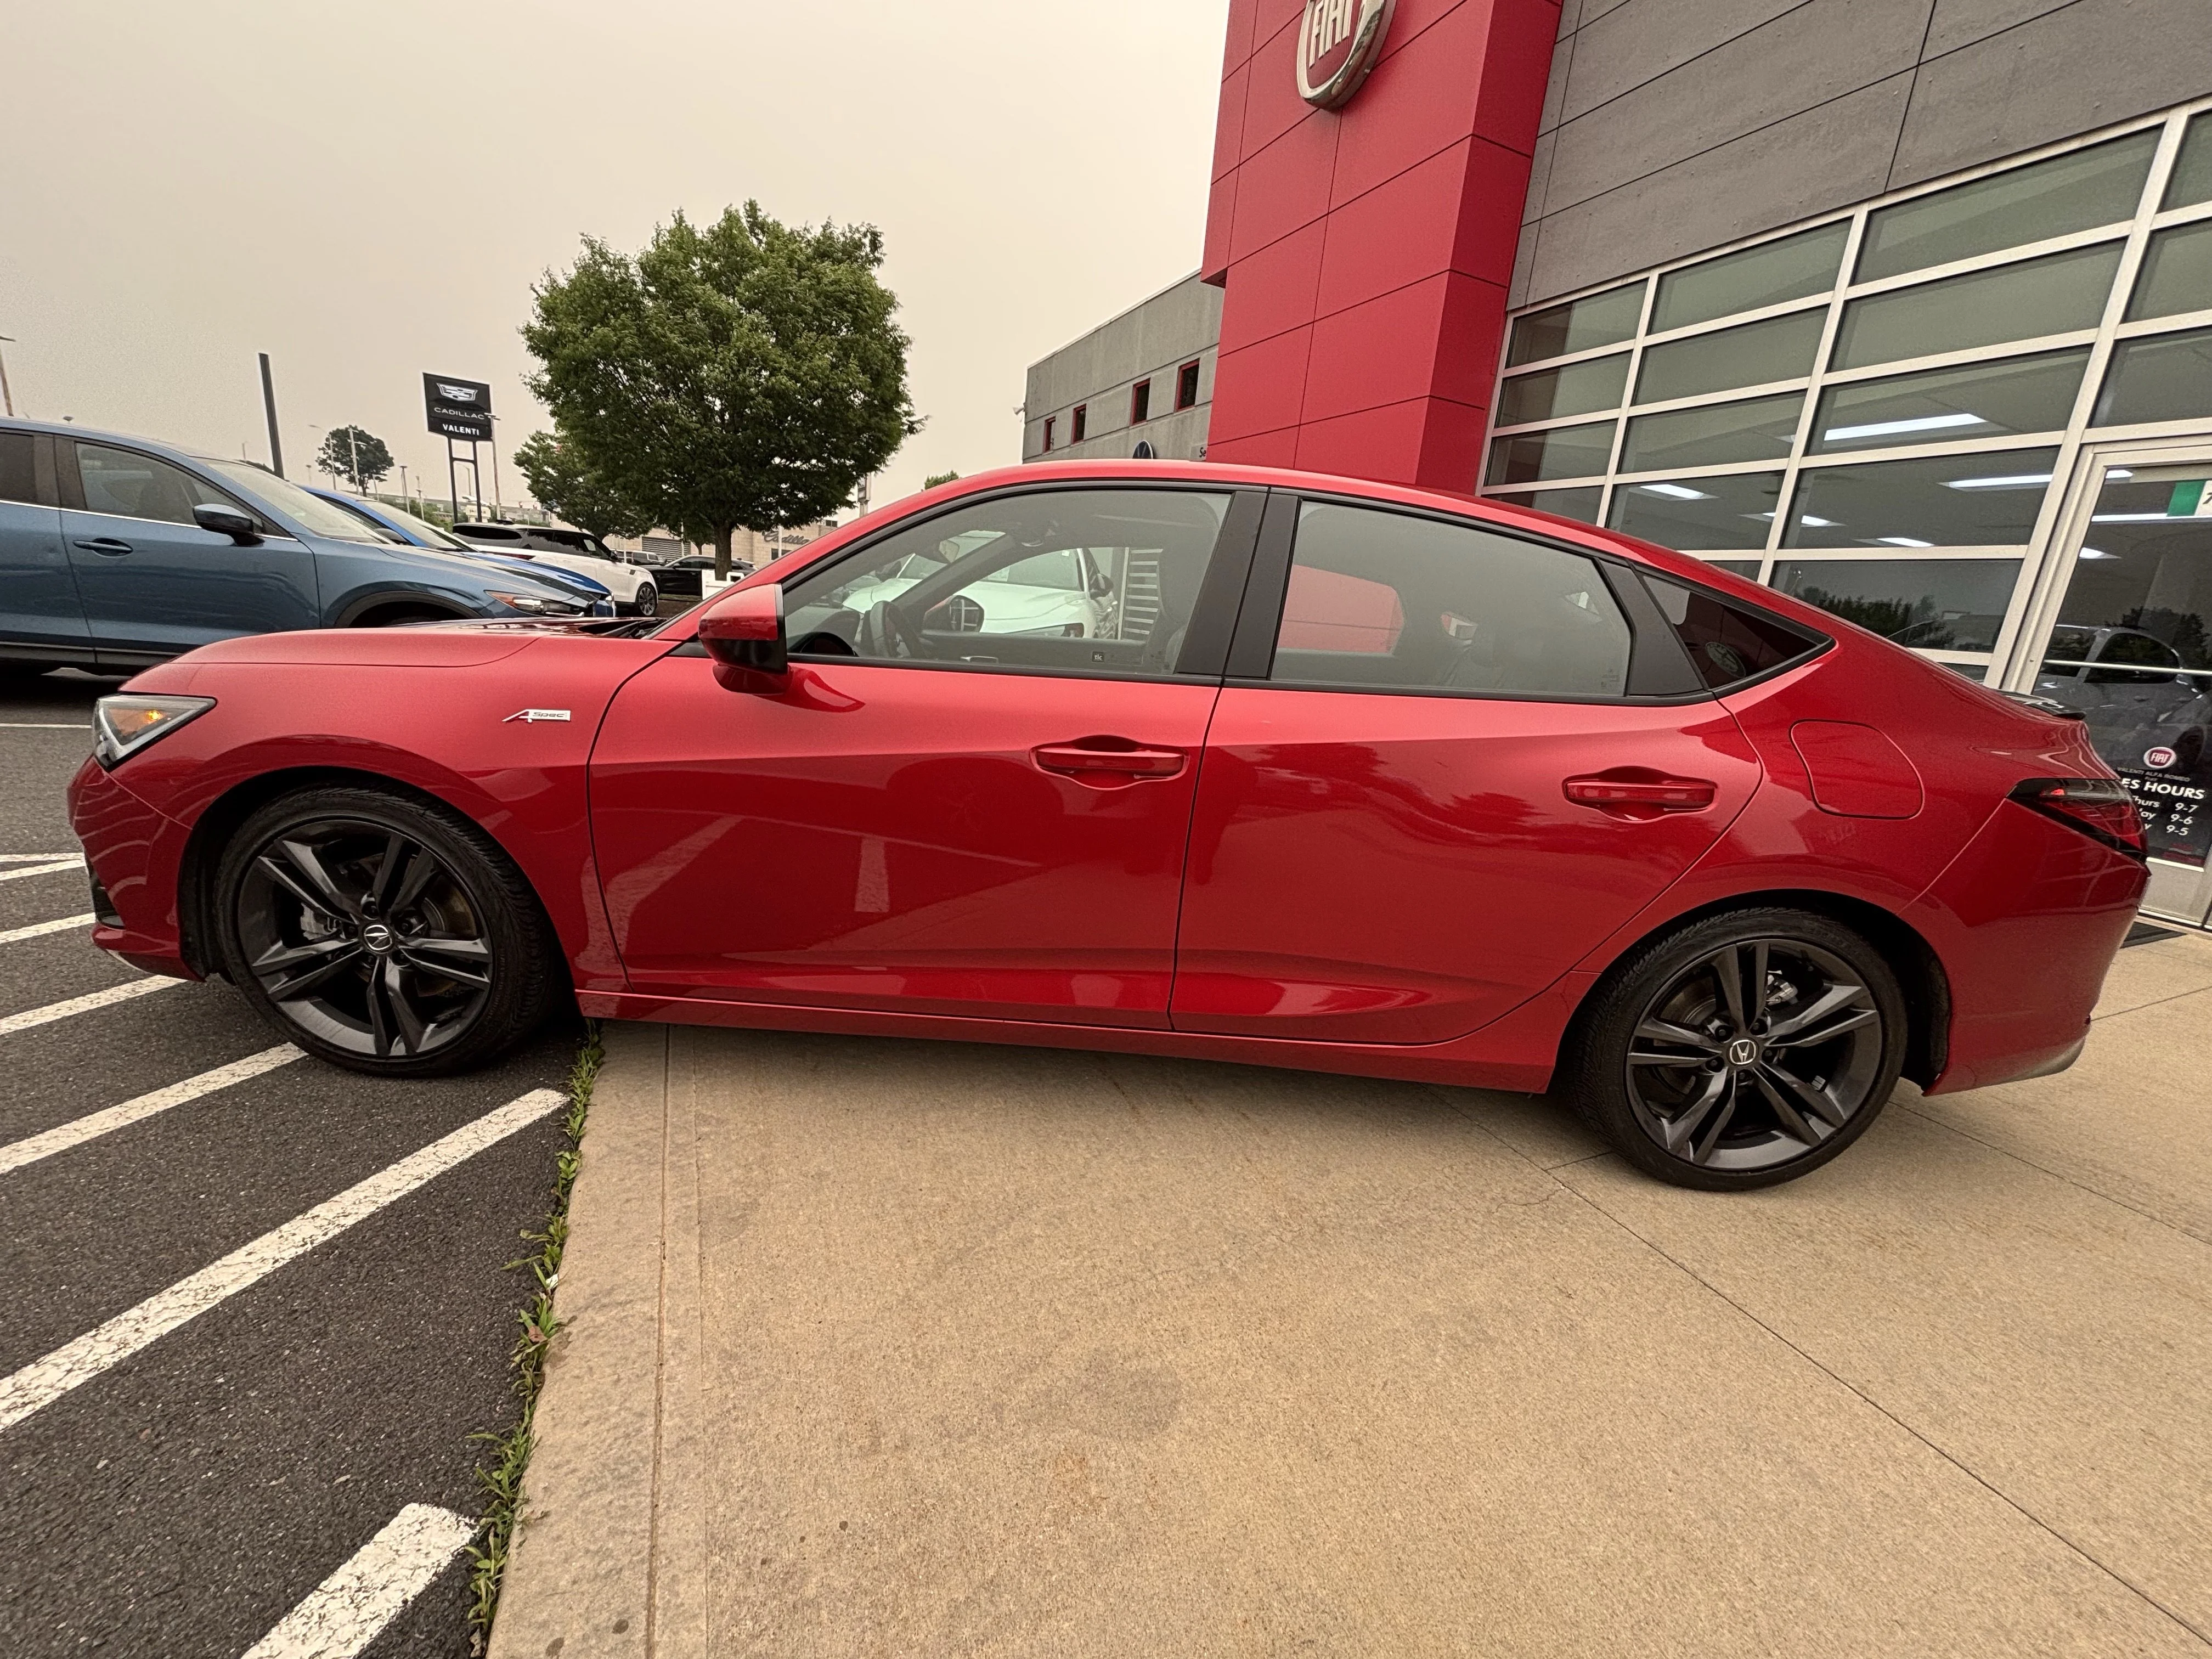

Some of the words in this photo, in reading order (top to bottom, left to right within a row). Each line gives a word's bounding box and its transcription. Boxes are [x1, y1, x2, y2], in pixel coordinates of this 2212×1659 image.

[434, 407, 485, 420] CADILLAC
[442, 423, 479, 436] VALENTI
[2150, 752, 2171, 763] FIAT
[2143, 781, 2205, 799] HOURS
[2175, 803, 2199, 813] 9-7
[2139, 808, 2157, 820] ay
[2170, 814, 2193, 825] 9-6
[2166, 825, 2190, 836] 9-5
